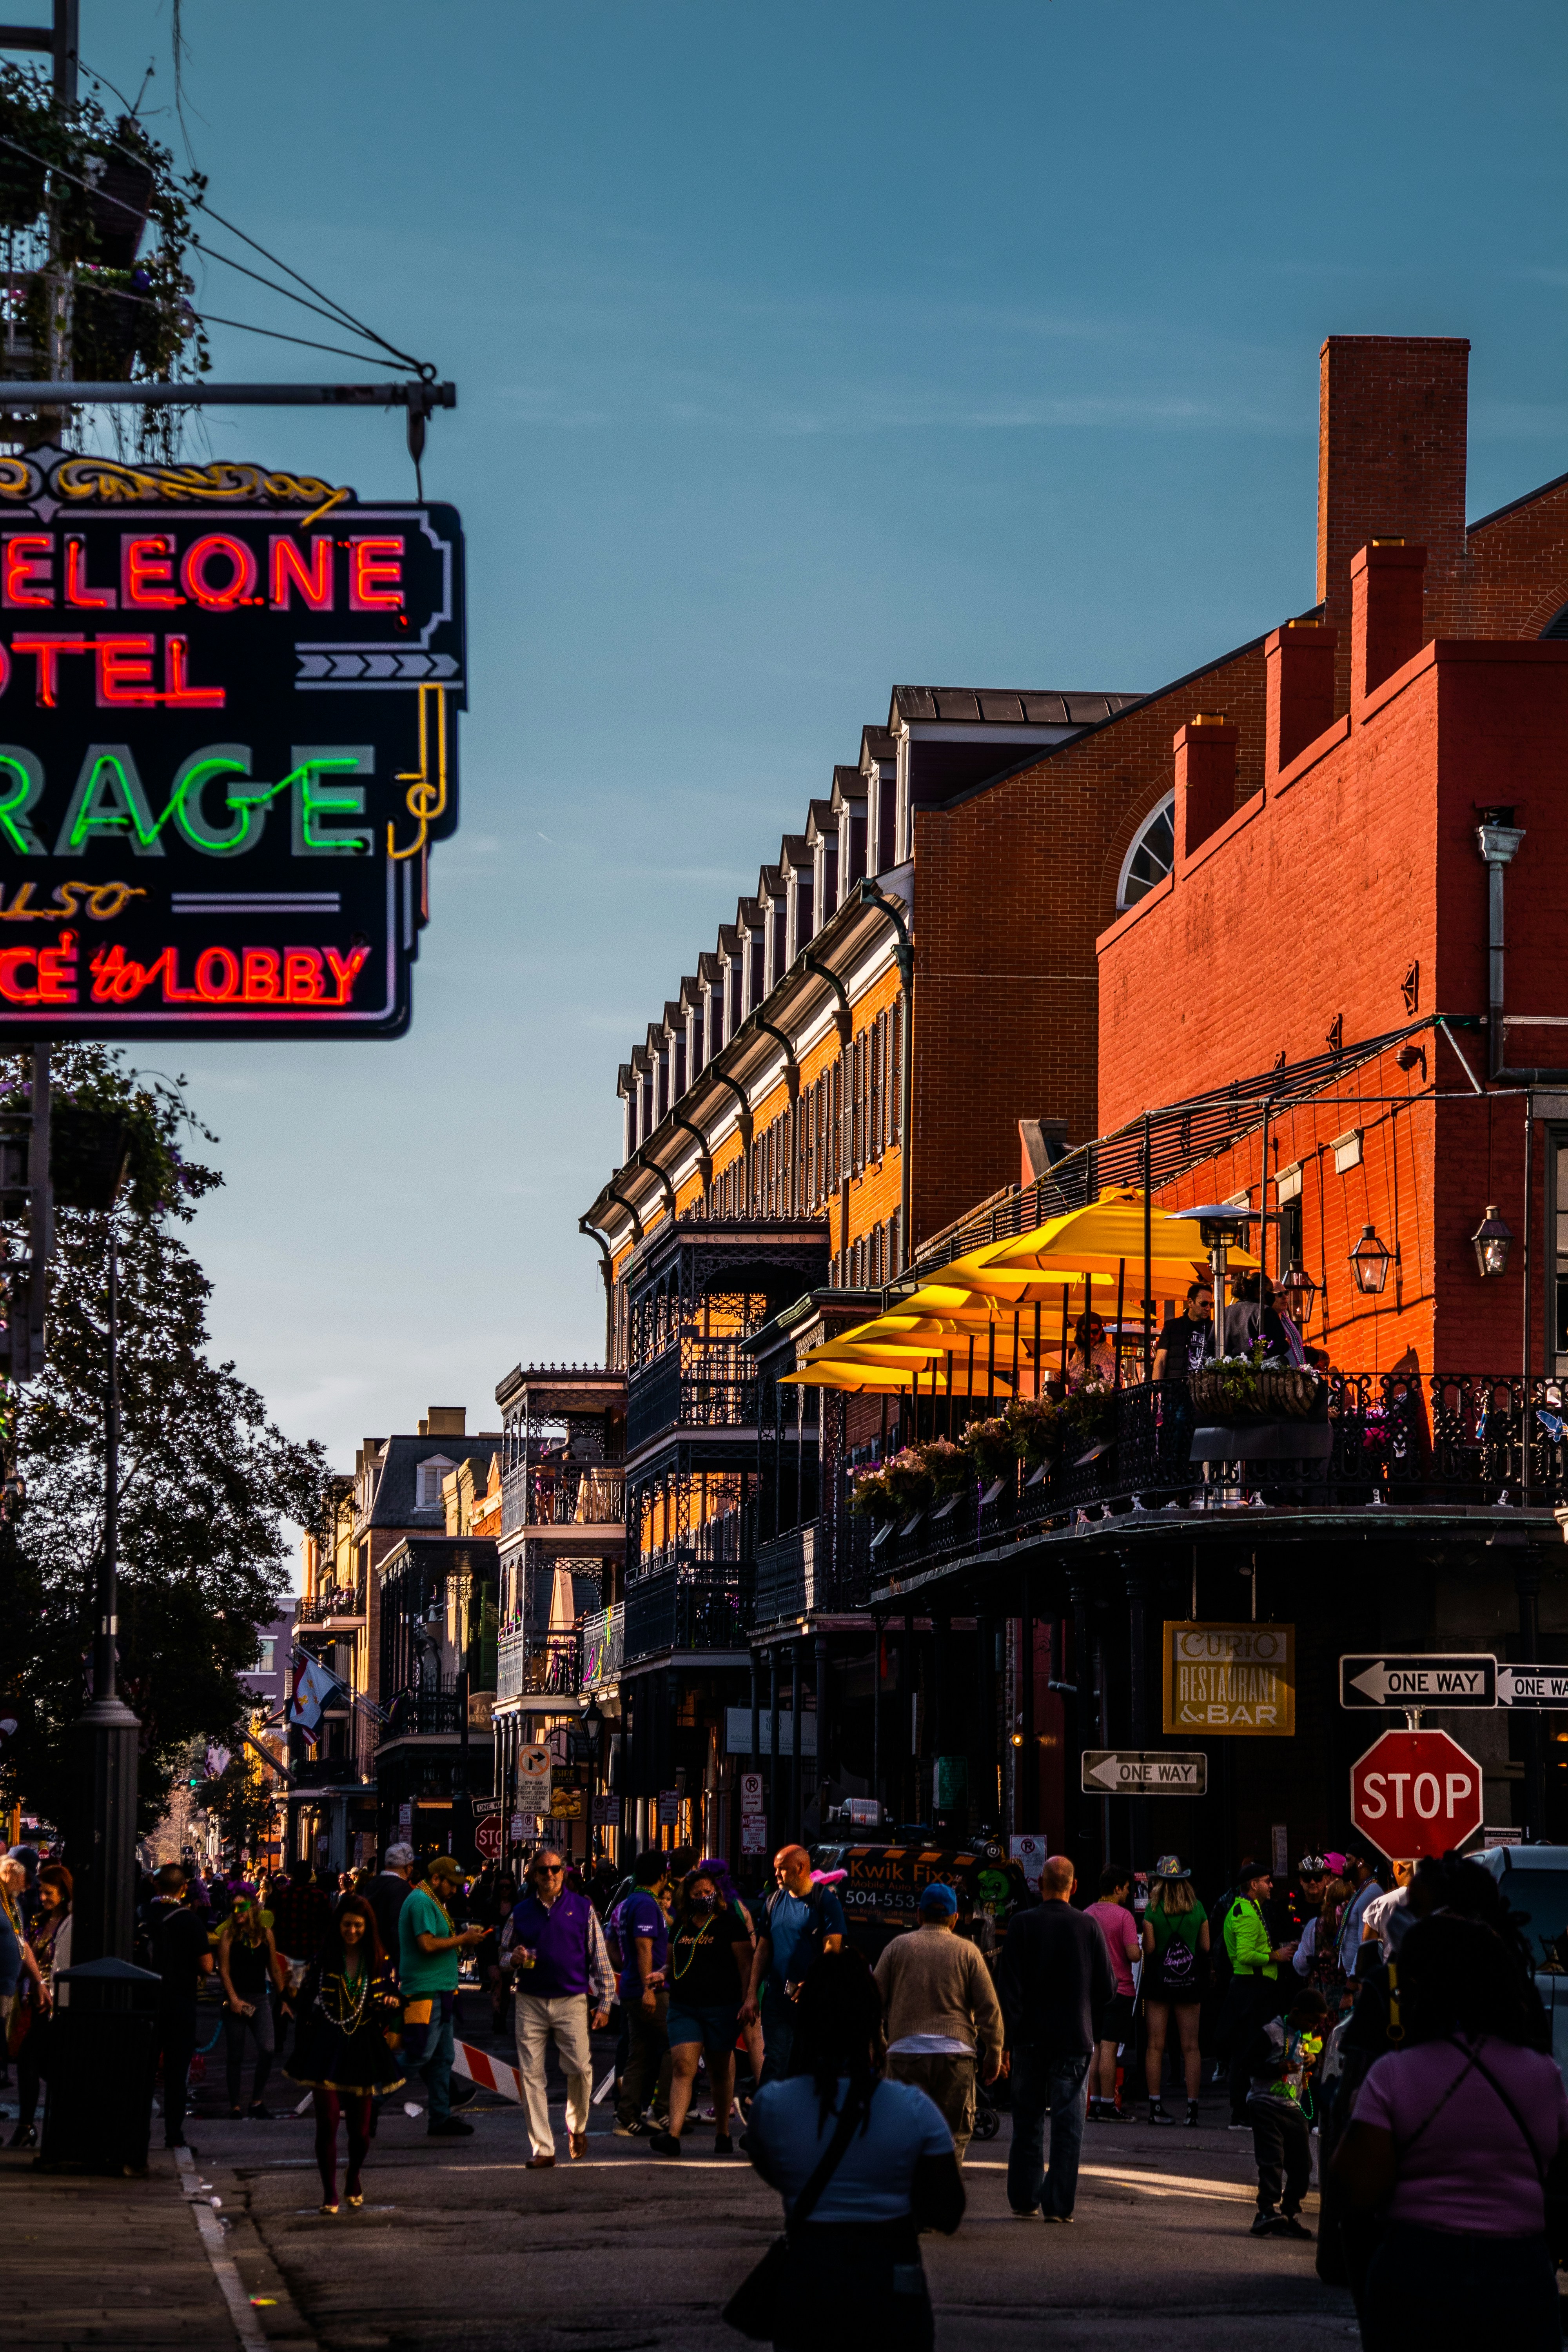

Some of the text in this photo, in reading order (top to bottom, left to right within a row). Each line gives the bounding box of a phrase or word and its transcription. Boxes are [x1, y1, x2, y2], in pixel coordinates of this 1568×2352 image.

[1, 532, 405, 612] ELEONE
[0, 633, 226, 707] TEL
[0, 881, 147, 921] LSO
[89, 942, 147, 1004] to
[162, 946, 370, 1004] LOBBY
[1180, 1632, 1279, 1659] CURIO
[1180, 1666, 1278, 1702] RESTAURANT
[1388, 1673, 1479, 1692] ONE WAY
[1514, 1679, 1545, 1695] ONE
[1120, 1765, 1192, 1781] ONE WAY
[1362, 1773, 1472, 1819] STOP
[743, 1817, 750, 1826] NO
[850, 1860, 904, 1881] Kwik
[851, 1880, 884, 1890] Mobile
[888, 1882, 912, 1892] Auto
